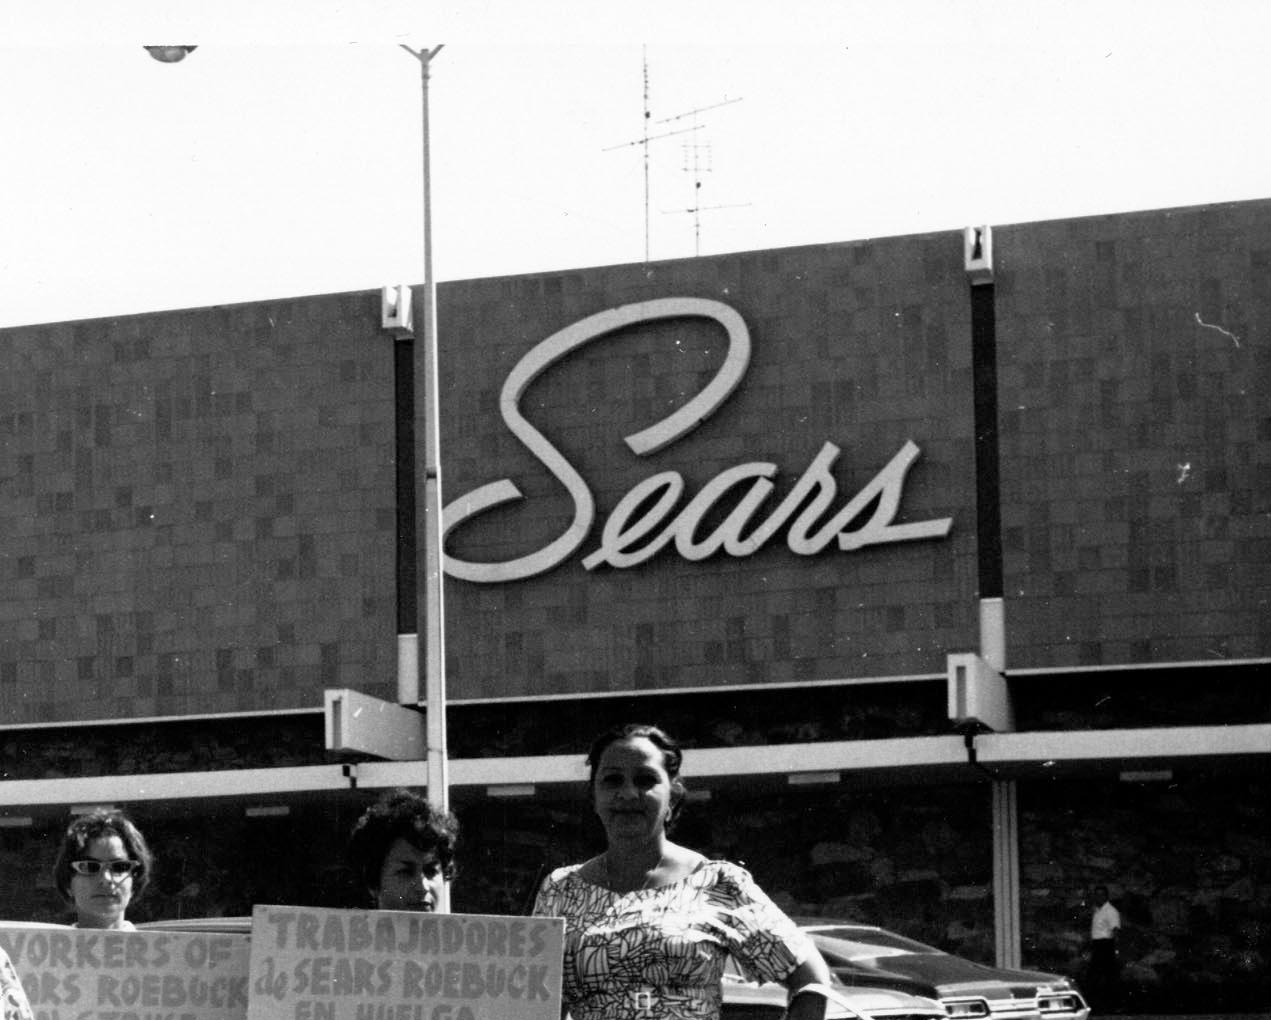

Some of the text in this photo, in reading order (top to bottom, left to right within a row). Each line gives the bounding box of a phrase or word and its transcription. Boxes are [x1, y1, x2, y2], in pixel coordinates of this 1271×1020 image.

[439, 297, 953, 583] Sears
[184, 936, 232, 969] OF
[267, 912, 548, 957] TRABAJADORES
[22, 972, 249, 1009] ARS ROEBUCK
[254, 956, 551, 1001] de SEARS ROEBUCK
